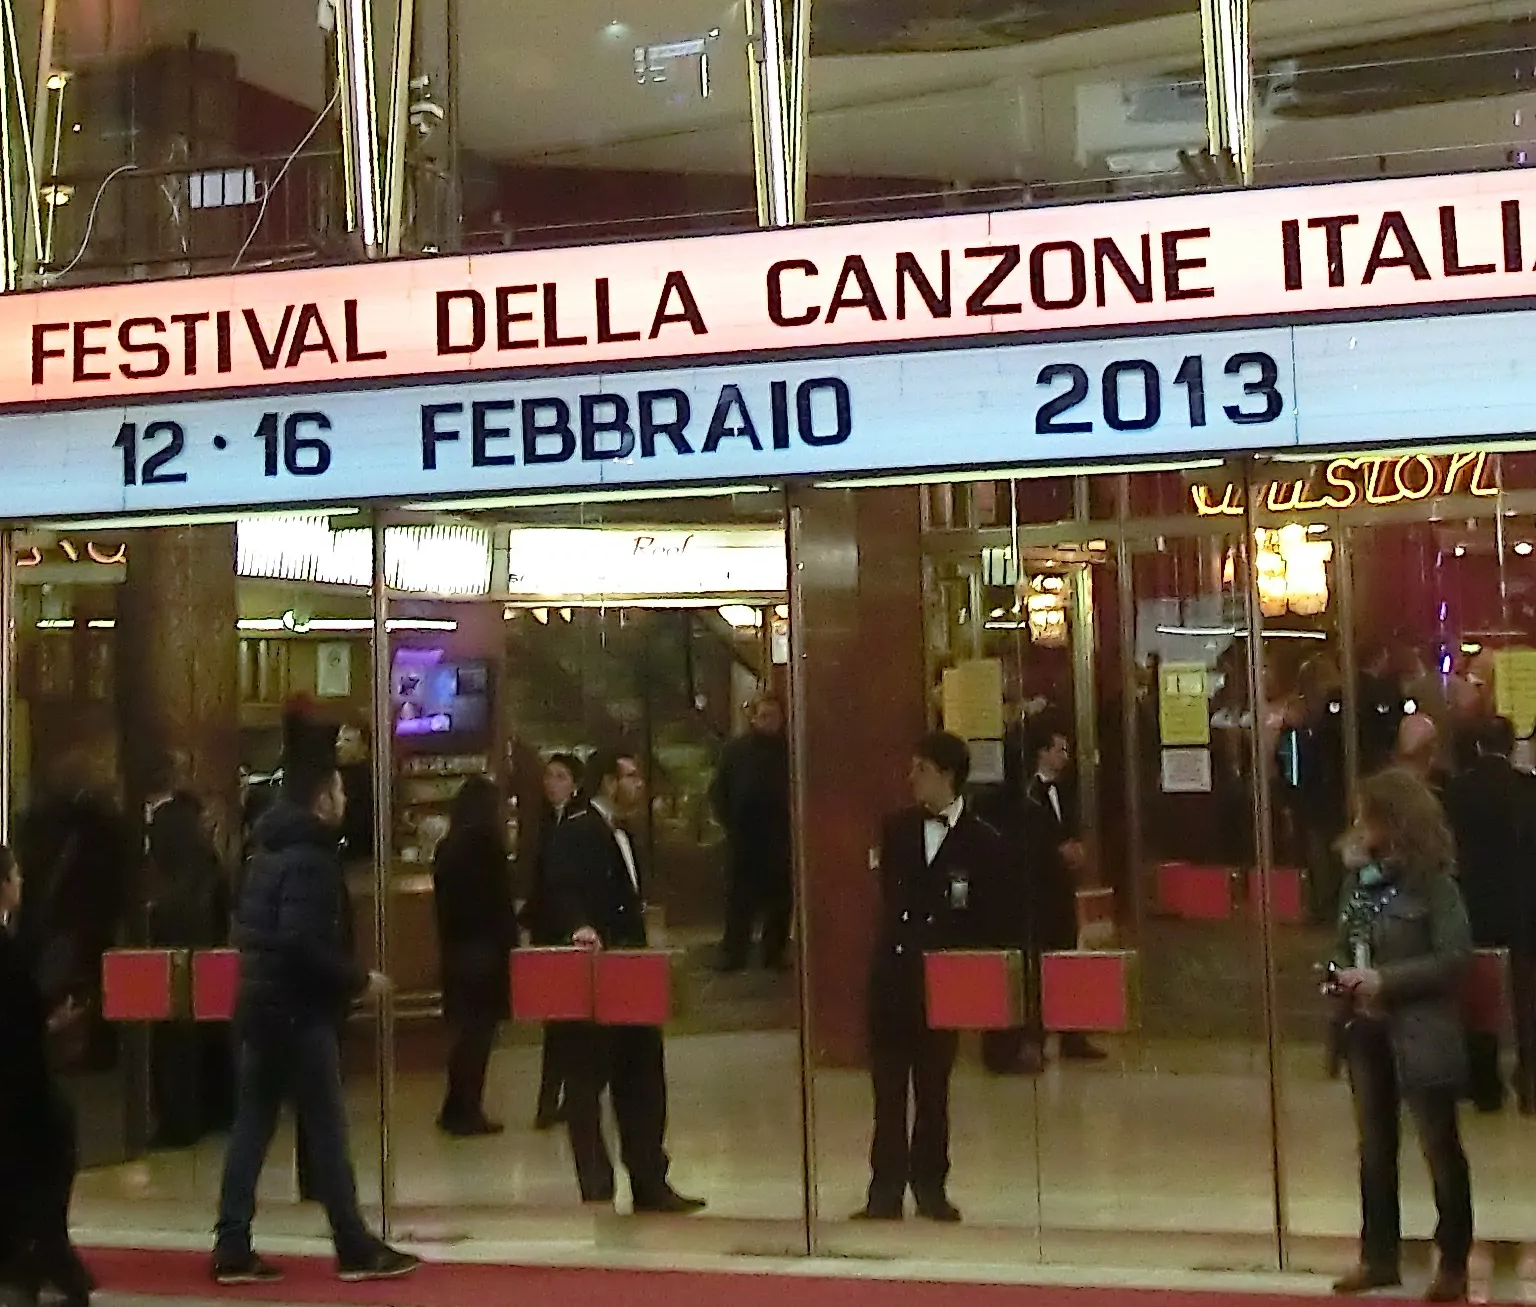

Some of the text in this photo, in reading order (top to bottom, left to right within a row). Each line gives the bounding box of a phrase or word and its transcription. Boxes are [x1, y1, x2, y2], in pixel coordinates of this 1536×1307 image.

[30, 298, 388, 385] FESTIVAL
[436, 270, 709, 357] DELLA
[765, 229, 1215, 328] CANZONE
[420, 375, 852, 471] FEBBRAIO
[1034, 352, 1285, 436] 2013
